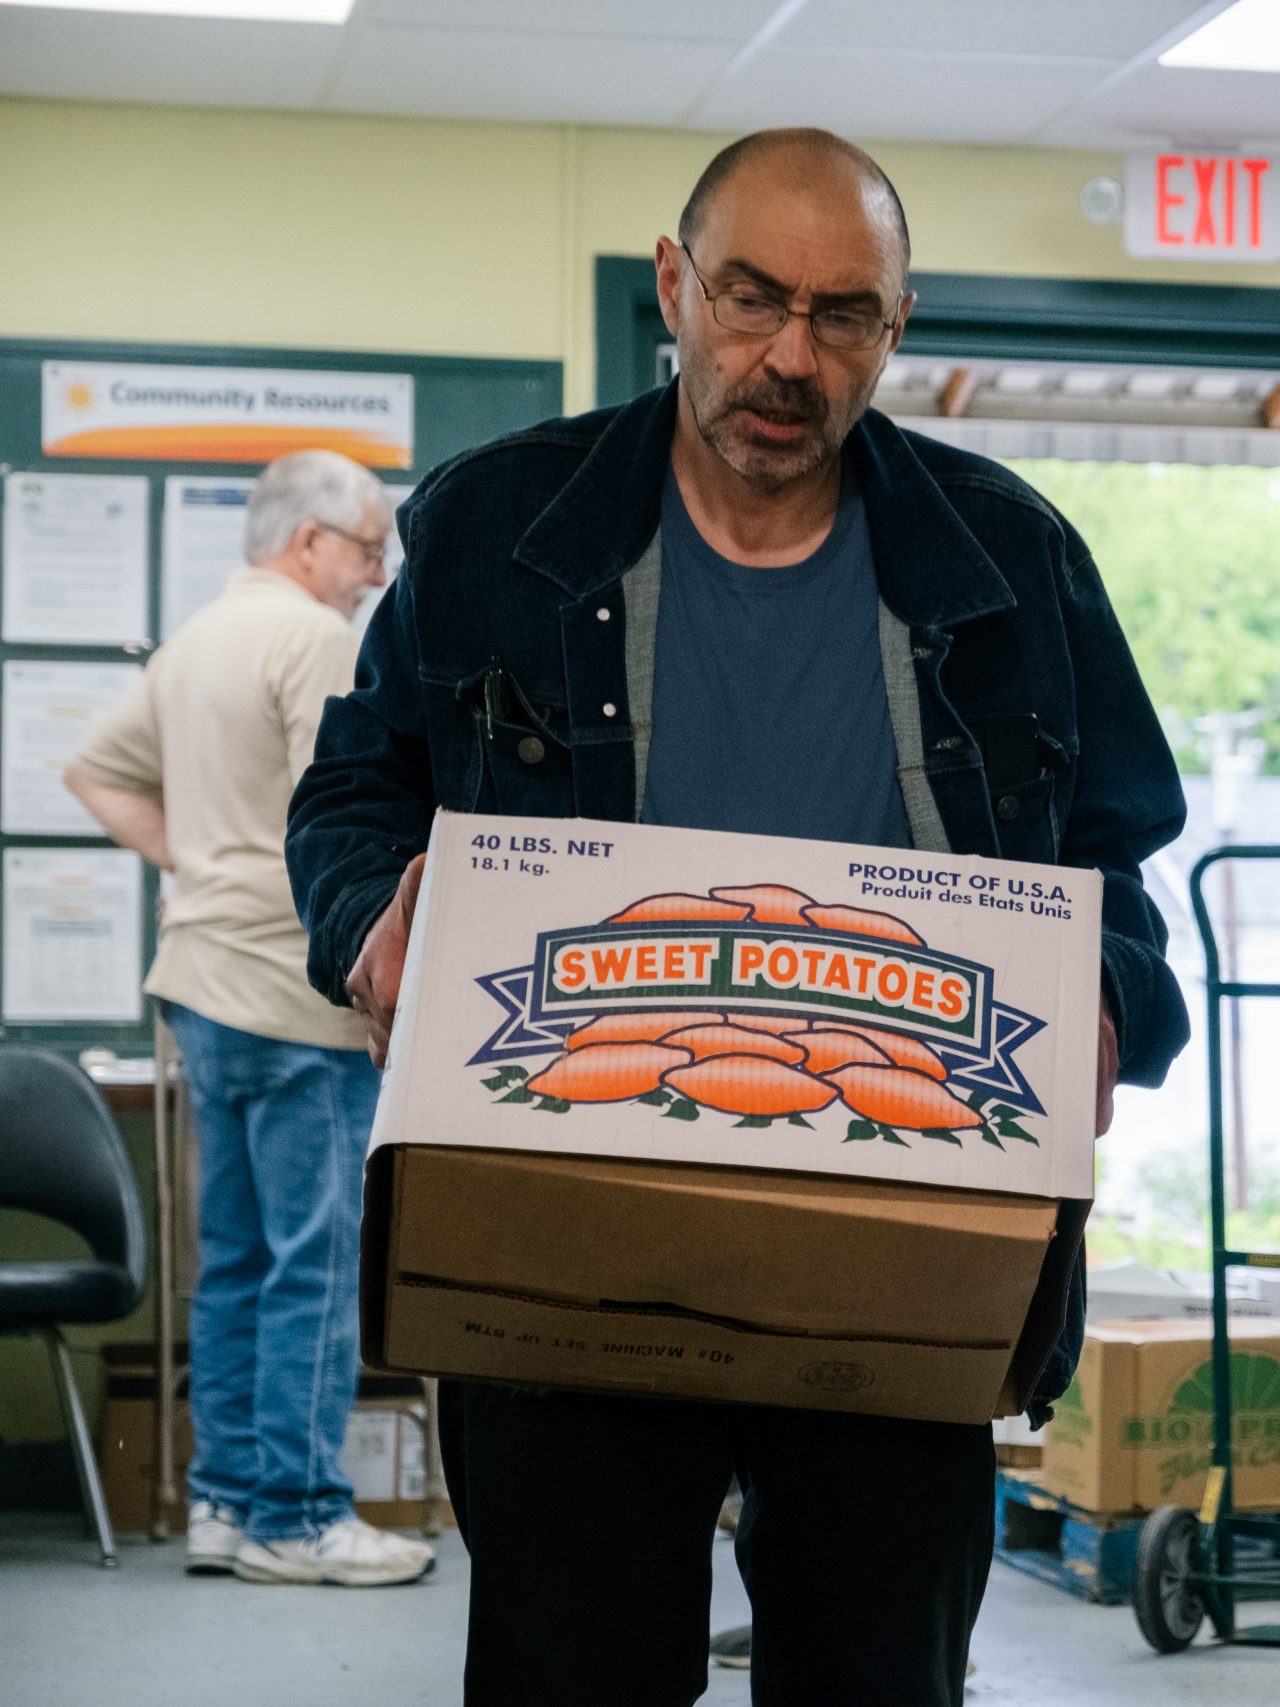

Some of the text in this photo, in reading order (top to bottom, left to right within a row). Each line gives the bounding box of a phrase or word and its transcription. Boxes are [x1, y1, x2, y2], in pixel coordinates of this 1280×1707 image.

[1155, 154, 1271, 249] EXIT
[109, 380, 390, 413] Community Resources
[471, 834, 615, 858] 40 LBS. NET
[471, 856, 551, 877] 18.1 kg.
[848, 863, 1073, 904] PRODUCT OF U.S.A.
[861, 881, 1073, 921] Produit des Etats Unis
[559, 944, 966, 1018] SWEET POTATOES
[516, 1332, 541, 1344] UP
[552, 1338, 587, 1350] SET
[600, 1342, 685, 1359] MACHINE
[699, 1349, 736, 1365] 40#
